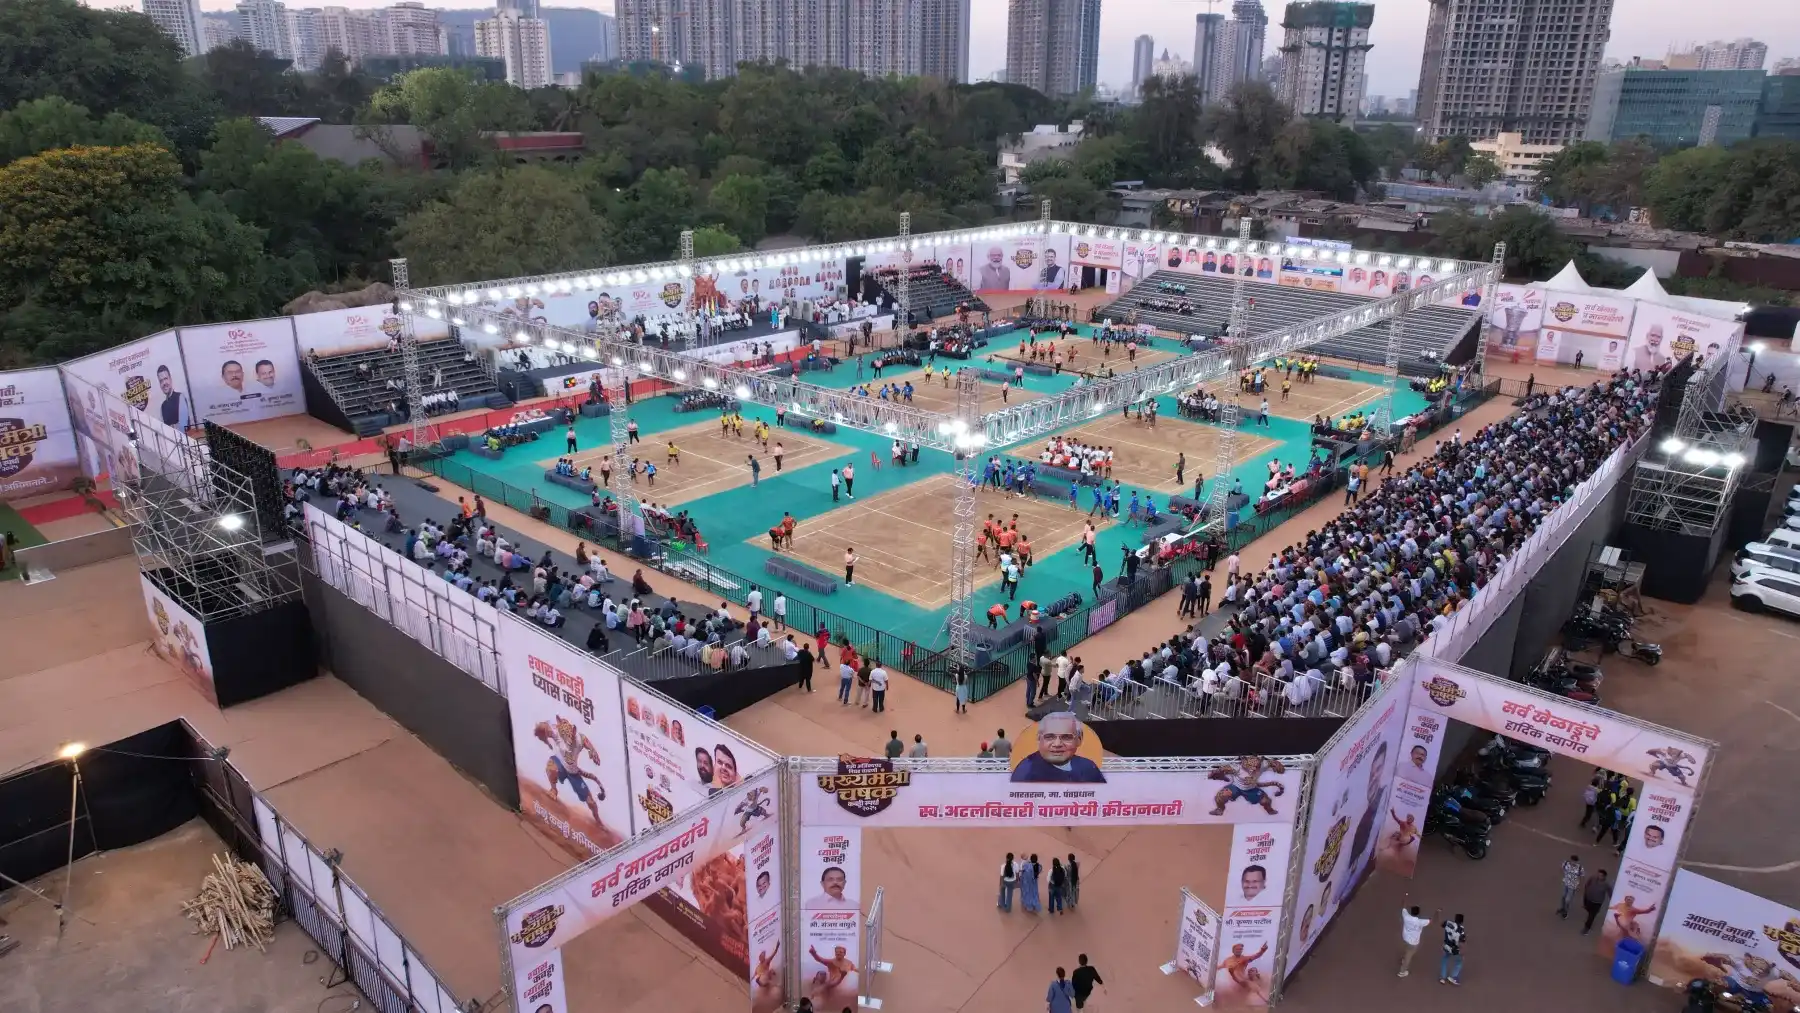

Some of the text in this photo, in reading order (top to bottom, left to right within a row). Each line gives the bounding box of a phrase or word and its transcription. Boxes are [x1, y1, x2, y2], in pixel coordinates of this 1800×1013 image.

[528, 655, 554, 678] श्वास
[533, 673, 560, 702] ध्यास
[1502, 700, 1602, 742] सर्व खेळाडूंचे
[1504, 719, 1590, 754] हार्दिक स्वागत
[818, 769, 910, 793] मुख्यमंत्री
[838, 786, 898, 801] चषक
[1038, 801, 1098, 818] वाजपेयी
[1102, 800, 1183, 817] क्रीडानगरी
[591, 817, 709, 898] सर्व मान्यवरांचे
[612, 851, 695, 907] हार्दिक स्वागत
[1681, 920, 1722, 937] आपला
[1686, 913, 1727, 930] आपली
